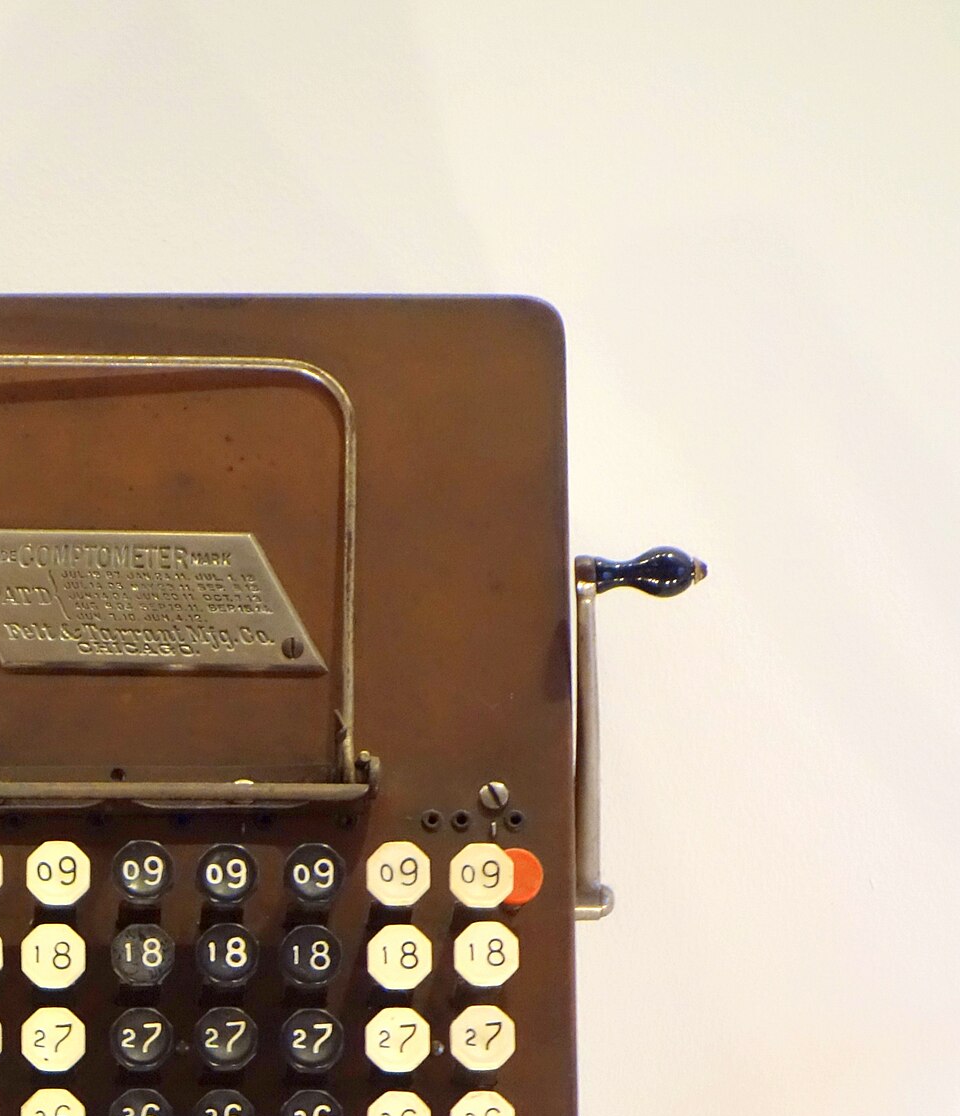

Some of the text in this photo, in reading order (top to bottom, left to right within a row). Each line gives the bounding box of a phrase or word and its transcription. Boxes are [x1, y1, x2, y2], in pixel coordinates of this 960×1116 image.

[18, 543, 188, 570] COMPTOMETER
[191, 552, 231, 566] MARK
[3, 622, 53, 642] Felt
[58, 624, 81, 642] &
[82, 623, 186, 645] Tarrant
